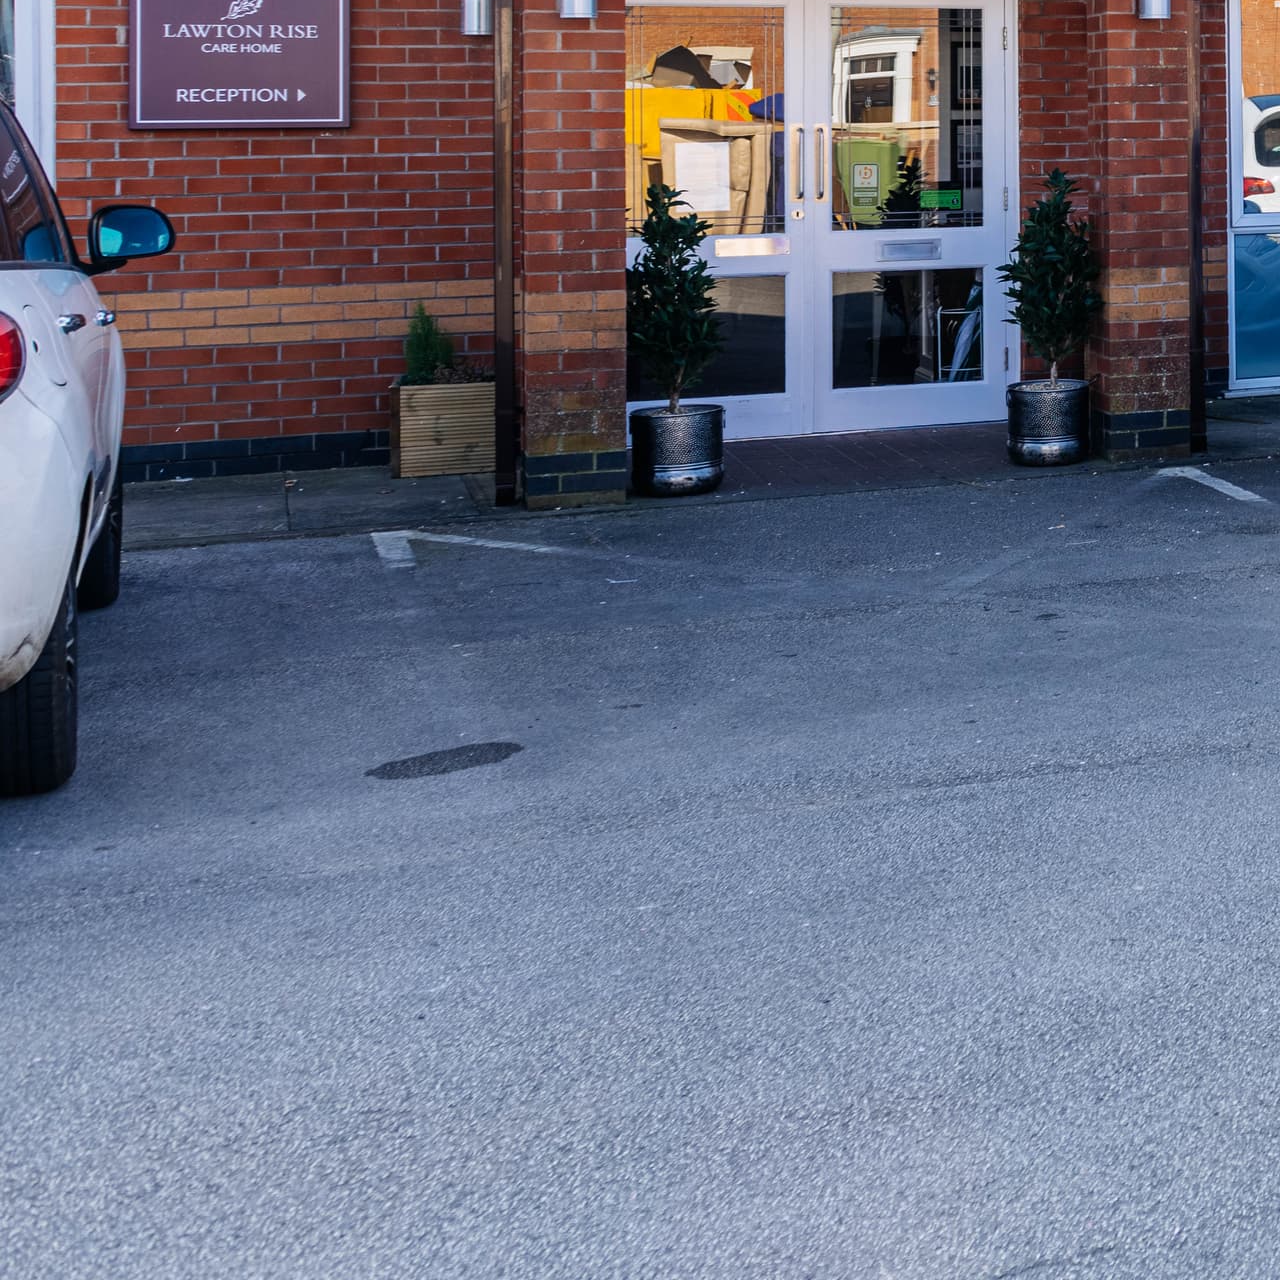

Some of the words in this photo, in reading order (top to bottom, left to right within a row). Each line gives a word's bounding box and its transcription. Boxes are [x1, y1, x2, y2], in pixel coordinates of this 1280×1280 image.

[162, 23, 264, 39] LAWTON
[269, 24, 320, 39] RISE
[200, 43, 238, 53] CARE
[240, 43, 283, 54] HOME
[176, 88, 288, 103] RECEPTION
